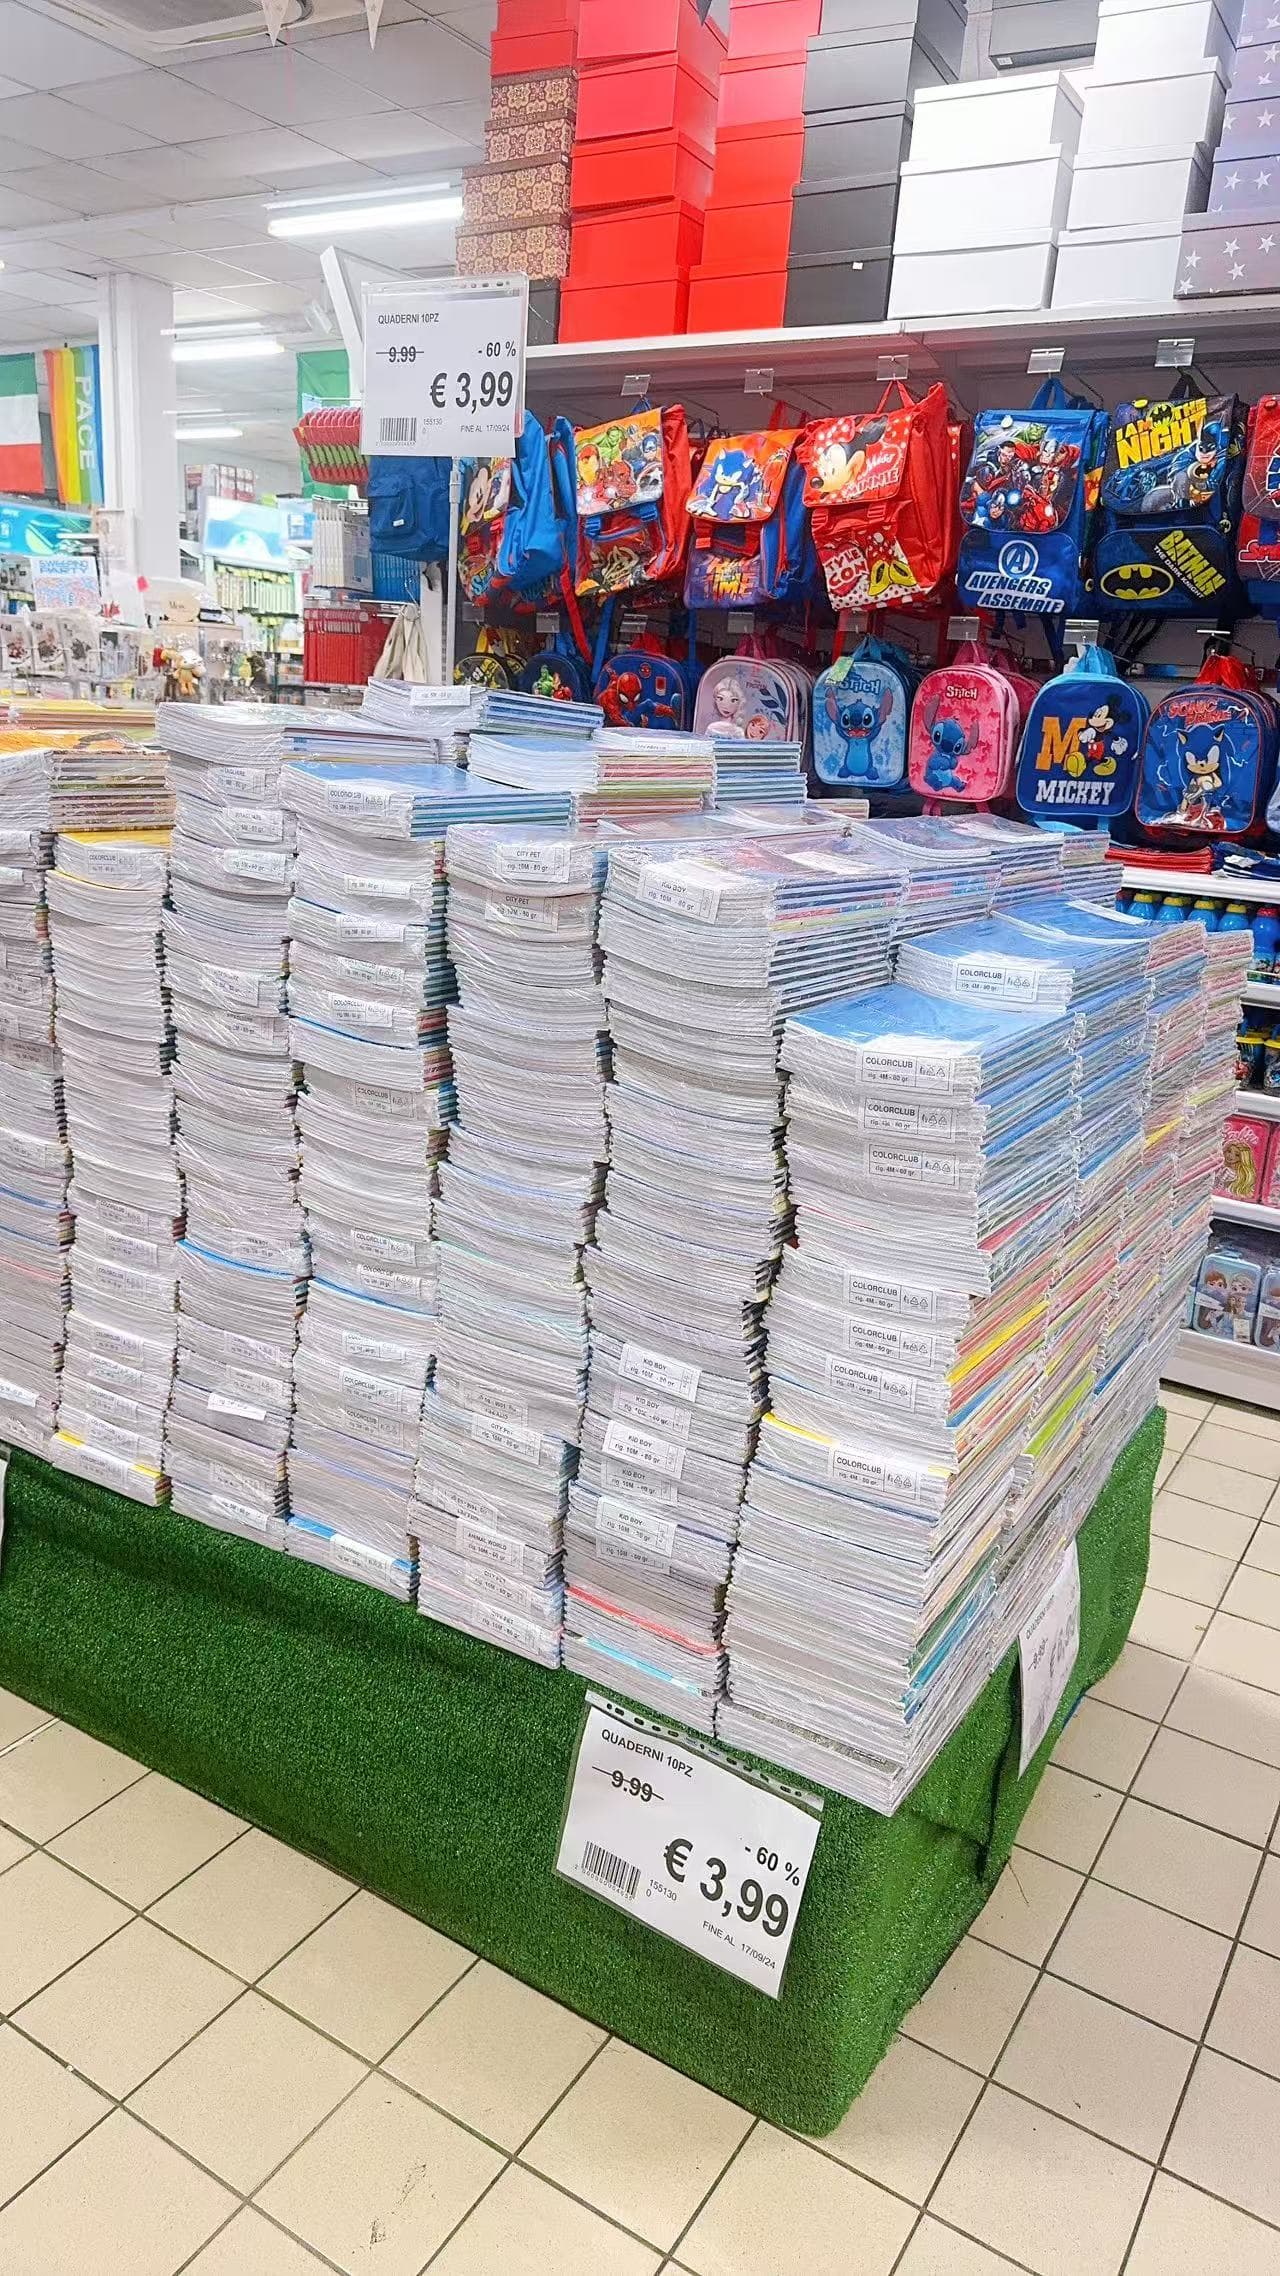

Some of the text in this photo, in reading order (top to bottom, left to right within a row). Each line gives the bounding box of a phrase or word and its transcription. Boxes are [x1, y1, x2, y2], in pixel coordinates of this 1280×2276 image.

[378, 313, 440, 325] QUADERNI 10PZ
[388, 346, 416, 363] 9.99
[486, 342, 501, 357] 60
[505, 340, 516, 357] %
[430, 371, 513, 414] € 3,99
[75, 375, 96, 471] PACE
[461, 424, 510, 433] FINE AL 17/09/24
[1125, 417, 1154, 438] AM
[1172, 398, 1207, 420] THE
[1117, 414, 1205, 469] NIGHT
[1153, 546, 1205, 600] THE DARK KNIGHT
[1158, 530, 1227, 597] BATMAN
[969, 574, 1050, 595] AVENGERS
[1035, 717, 1087, 772] M
[1035, 780, 1115, 805] MICKEY
[960, 969, 1002, 980] COLORCLUB
[865, 1056, 913, 1069] COLORCLUB
[868, 1104, 916, 1117] COLORCLUB
[872, 1150, 919, 1163] COLORCLUB
[852, 1280, 898, 1297] COLORCLUB
[852, 1325, 897, 1342] COLORCLUB
[834, 1364, 879, 1383] COLORCLUB
[836, 1456, 882, 1474] COLORCLUB
[601, 1728, 694, 1778] QUADERNI 10PZ
[611, 1770, 653, 1802] 9.99
[756, 1846, 779, 1872] 60
[784, 1861, 800, 1887] %
[649, 1879, 677, 1902] 155130
[663, 1838, 789, 1938] € 3,99
[702, 1920, 777, 1970] FINE AL 17/09/24
